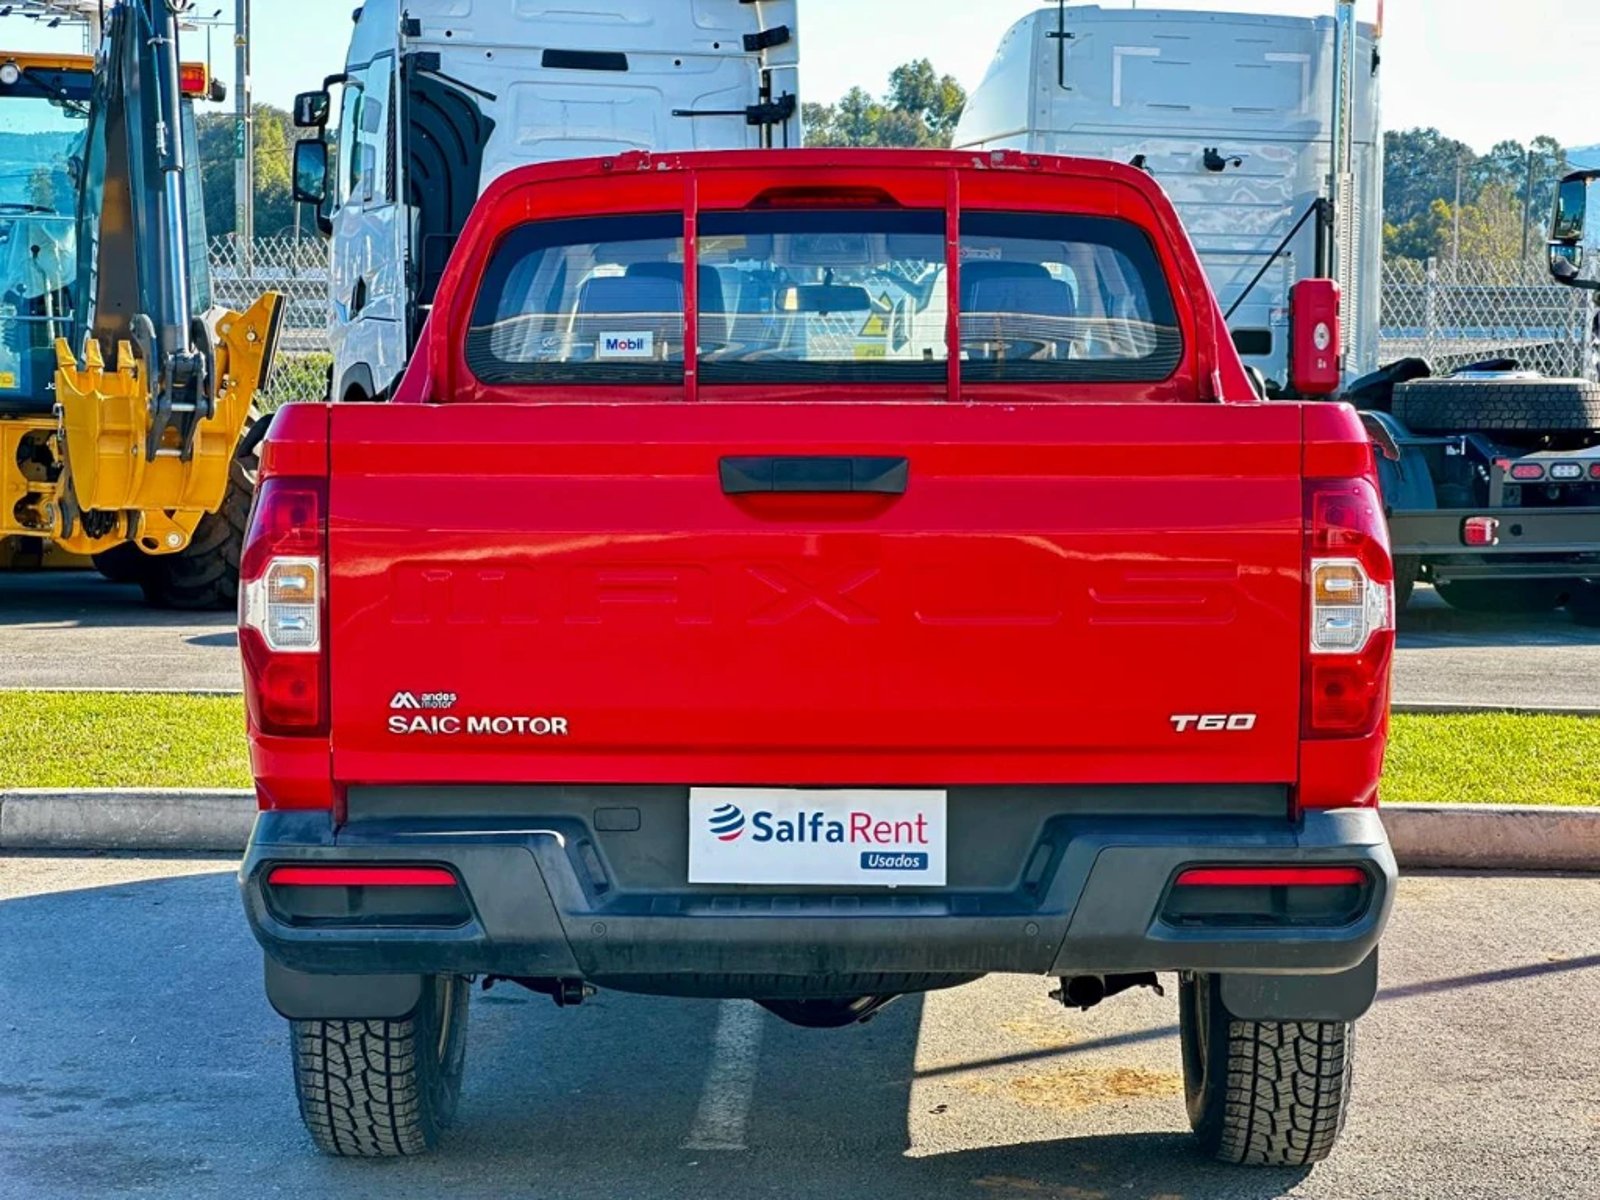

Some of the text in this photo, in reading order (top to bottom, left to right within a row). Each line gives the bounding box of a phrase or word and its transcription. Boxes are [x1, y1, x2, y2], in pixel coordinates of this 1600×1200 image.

[606, 338, 644, 350] Mobil
[421, 692, 456, 701] andes
[388, 715, 568, 735] SAIC MOTOR
[1169, 713, 1257, 732] T60
[868, 854, 920, 868] Usados
